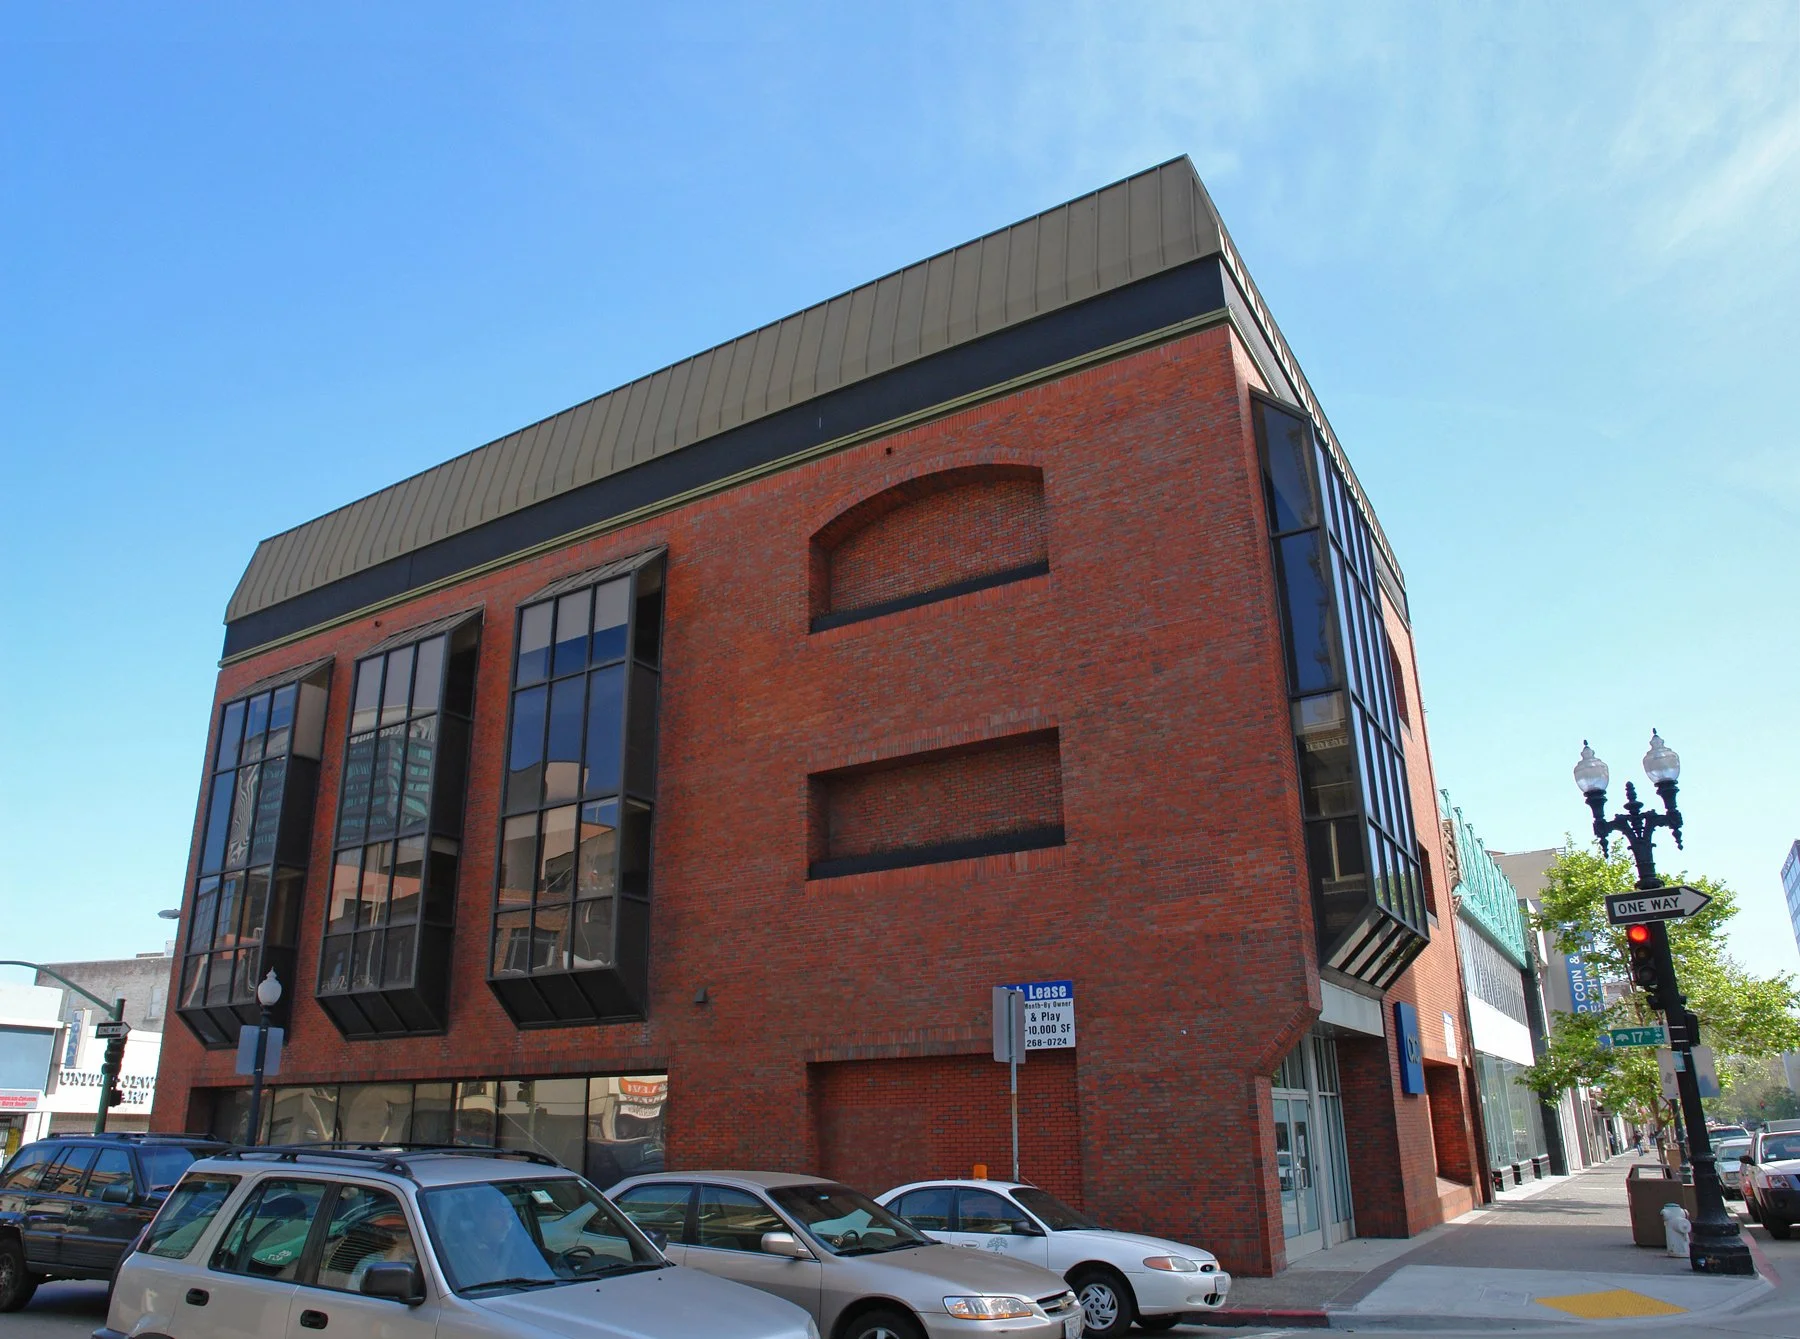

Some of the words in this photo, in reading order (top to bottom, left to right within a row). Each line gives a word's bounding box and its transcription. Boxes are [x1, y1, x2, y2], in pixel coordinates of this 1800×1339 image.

[1618, 901, 1646, 914] ONE
[1651, 897, 1680, 912] WAY
[1571, 969, 1586, 1001] COIN
[1029, 985, 1067, 1000] Lease
[1030, 1012, 1037, 1022] &
[1041, 1011, 1061, 1022] Play
[1061, 1023, 1071, 1033] SF
[1027, 1038, 1067, 1047] 268-0724
